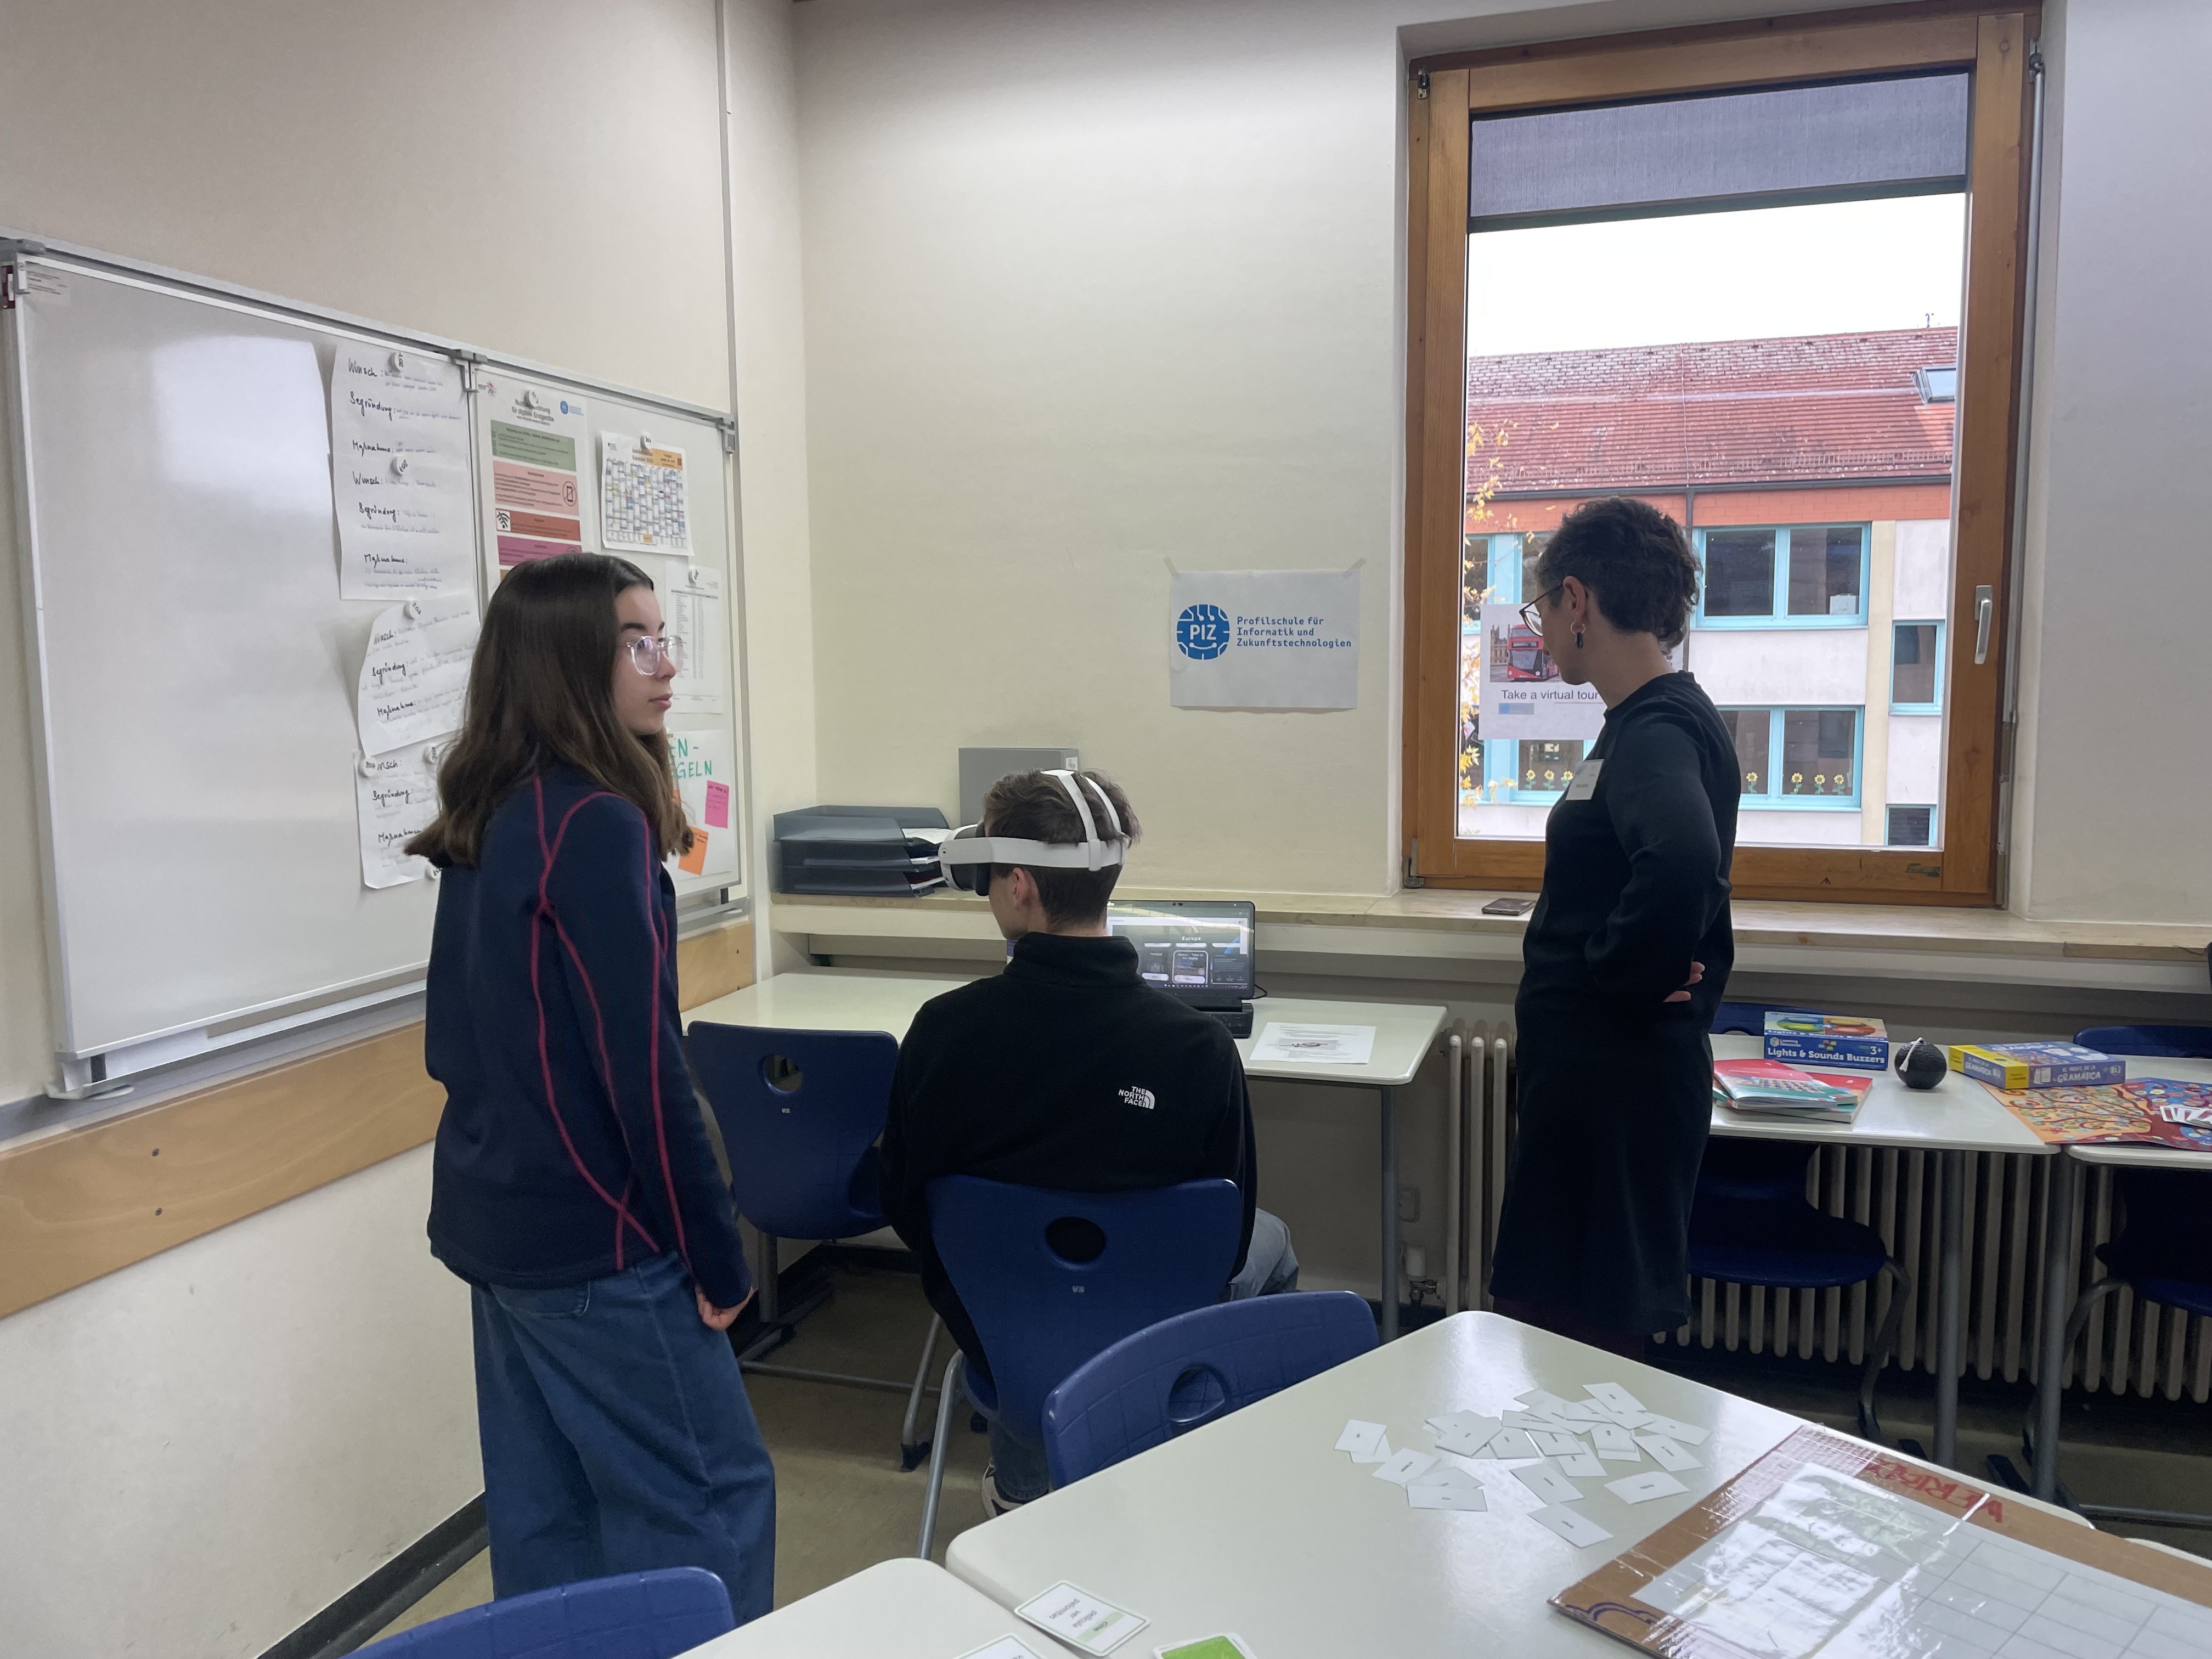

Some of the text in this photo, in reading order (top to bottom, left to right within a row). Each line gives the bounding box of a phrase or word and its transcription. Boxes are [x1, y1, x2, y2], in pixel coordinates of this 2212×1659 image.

[1237, 616, 1324, 625] Profilschule für
[1190, 624, 1217, 640] PIZ
[1237, 628, 1314, 636] Informatik und
[1237, 638, 1351, 648] Zukunftstechnologien
[1502, 690, 1527, 699] Take
[1541, 690, 1573, 699] virtual
[1577, 690, 1599, 699] tour
[1870, 1046, 1883, 1055] 3+
[1767, 1047, 1885, 1064] Lights & Sounds Buzzers
[1118, 1089, 1145, 1101] NORTH
[1131, 1086, 1146, 1095] THE
[1125, 1097, 1144, 1107] FACE
